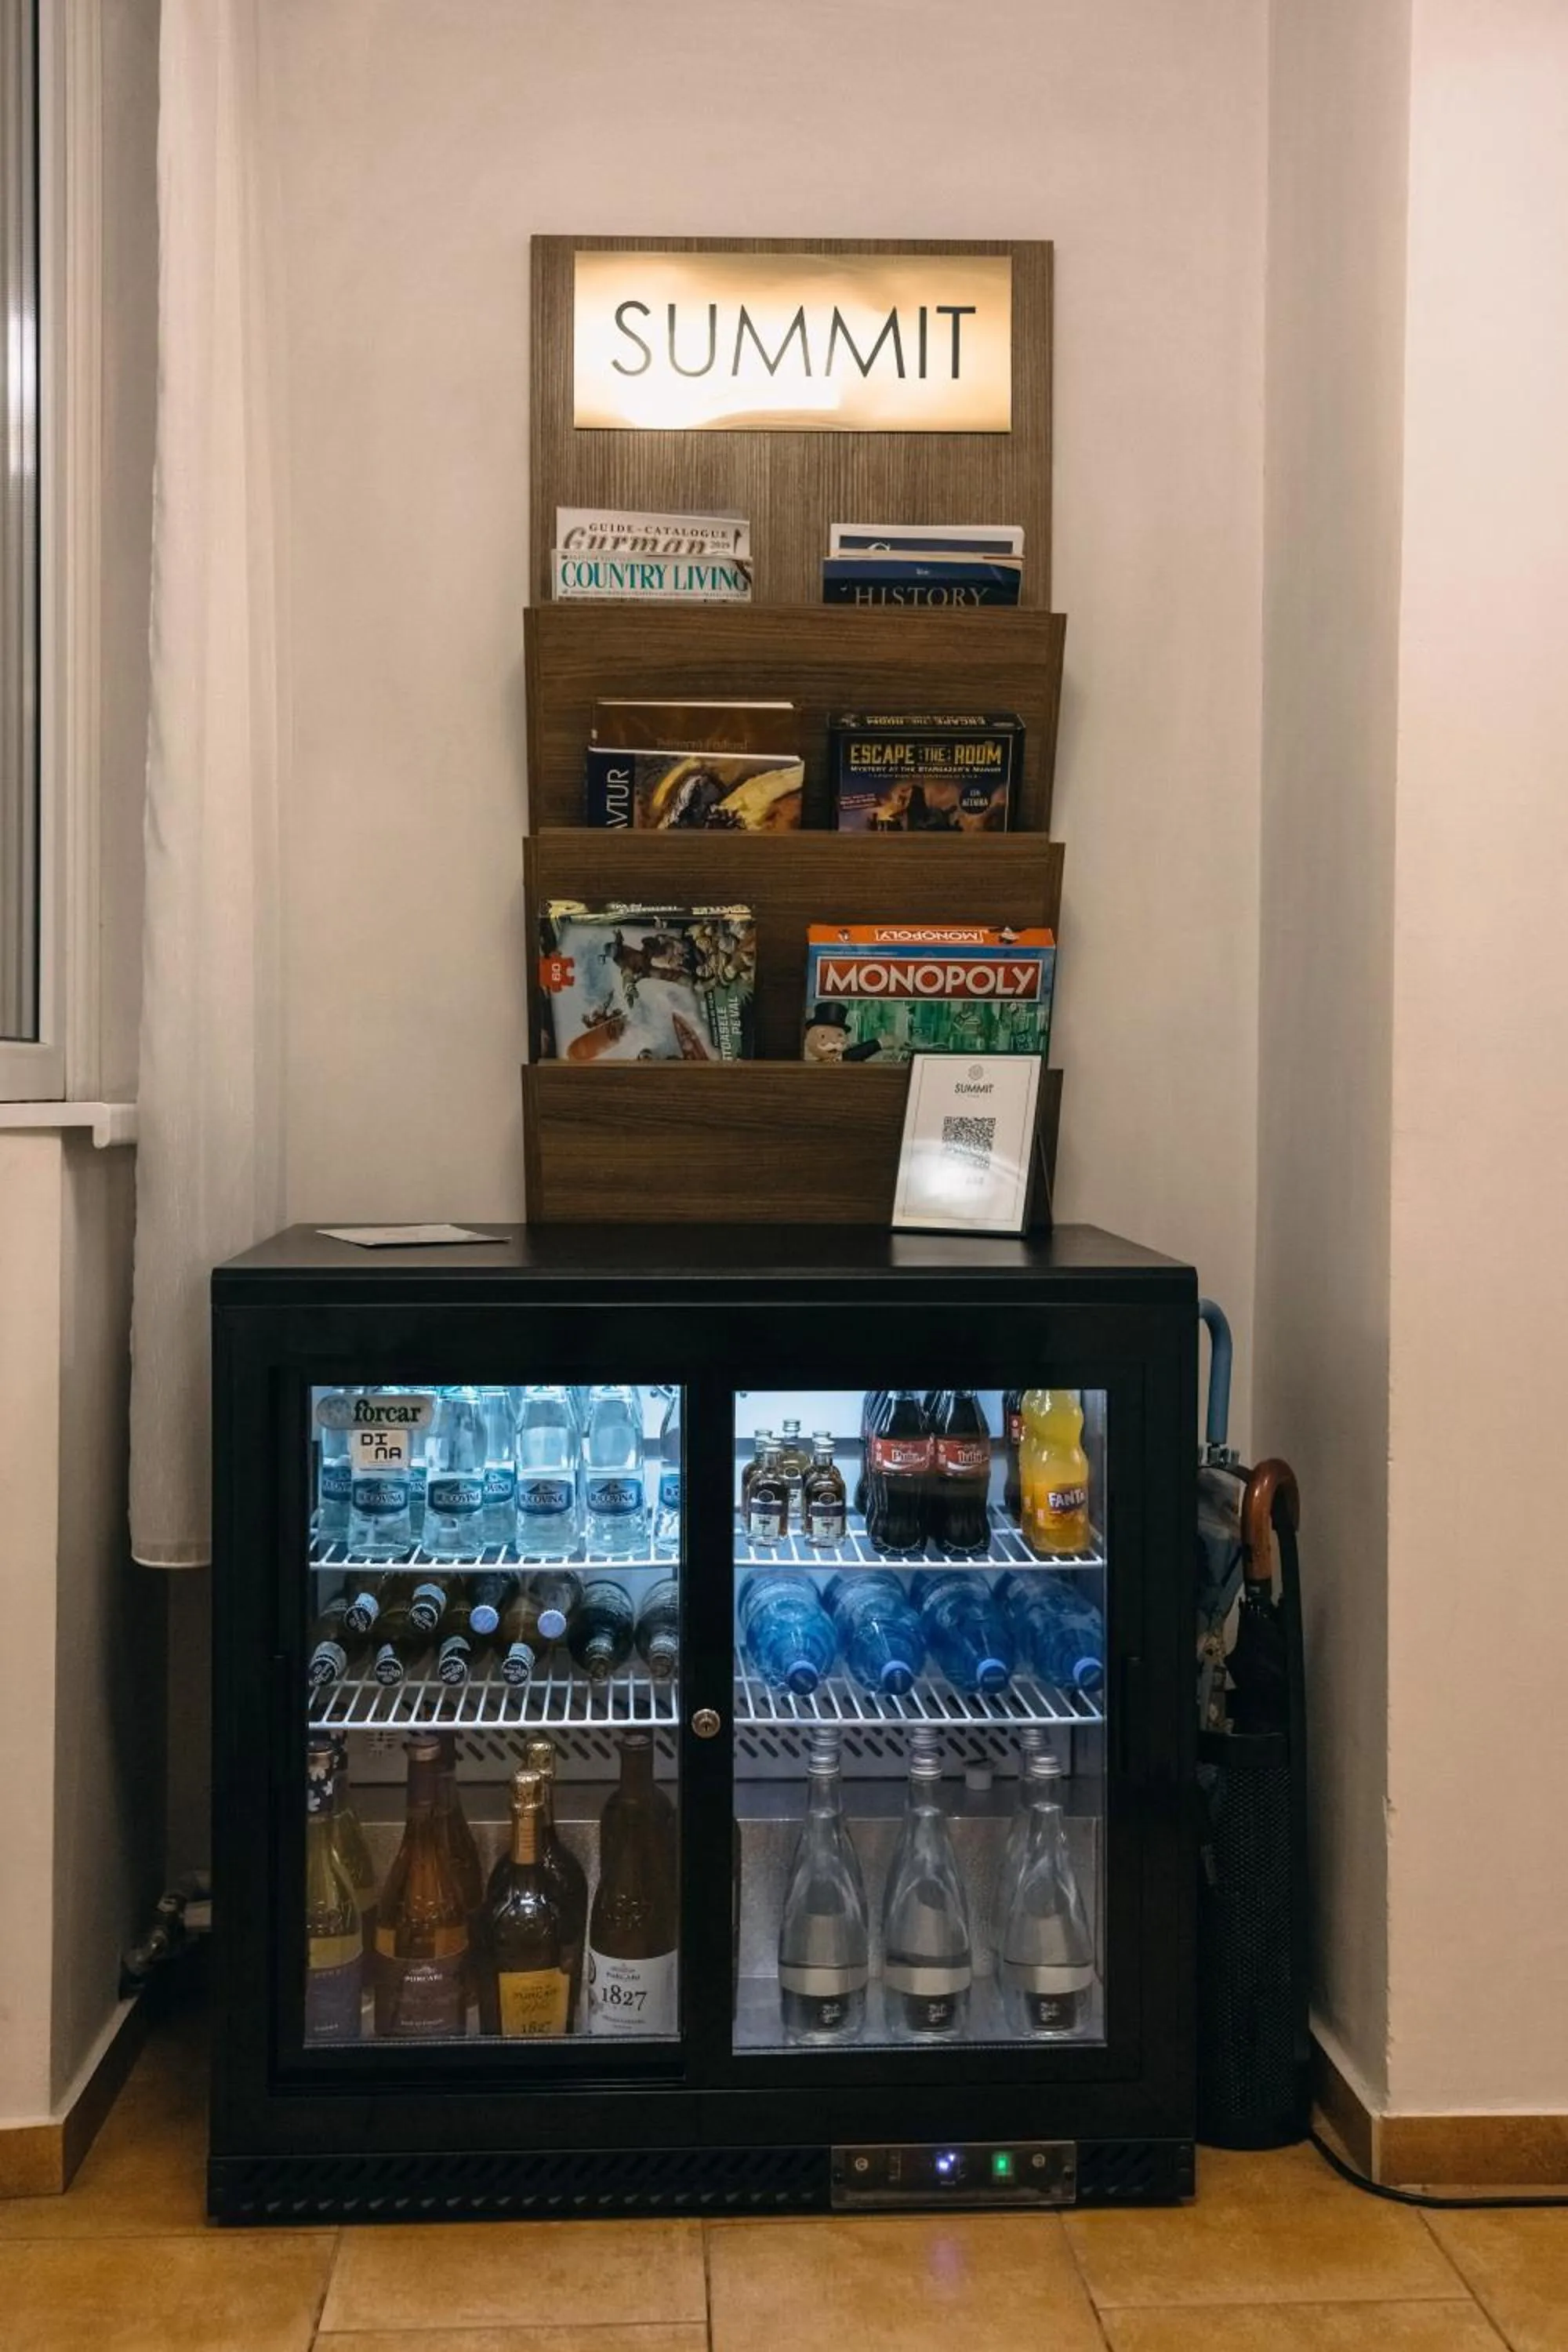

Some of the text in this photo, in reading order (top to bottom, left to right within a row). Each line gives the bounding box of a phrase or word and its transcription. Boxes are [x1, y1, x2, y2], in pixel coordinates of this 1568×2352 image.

[612, 300, 975, 379] SUMMIT
[561, 561, 748, 591] COUNTRY LIVING
[855, 586, 989, 607] HISTORY
[850, 744, 915, 765] ESCAPE
[954, 742, 1001, 765] ROOM
[880, 930, 979, 942] MONOPOLY
[824, 963, 1036, 995] MONOPOLY
[954, 1083, 994, 1094] SUMMIT
[354, 1399, 421, 1422] forcar
[602, 1984, 648, 2011] 1827
